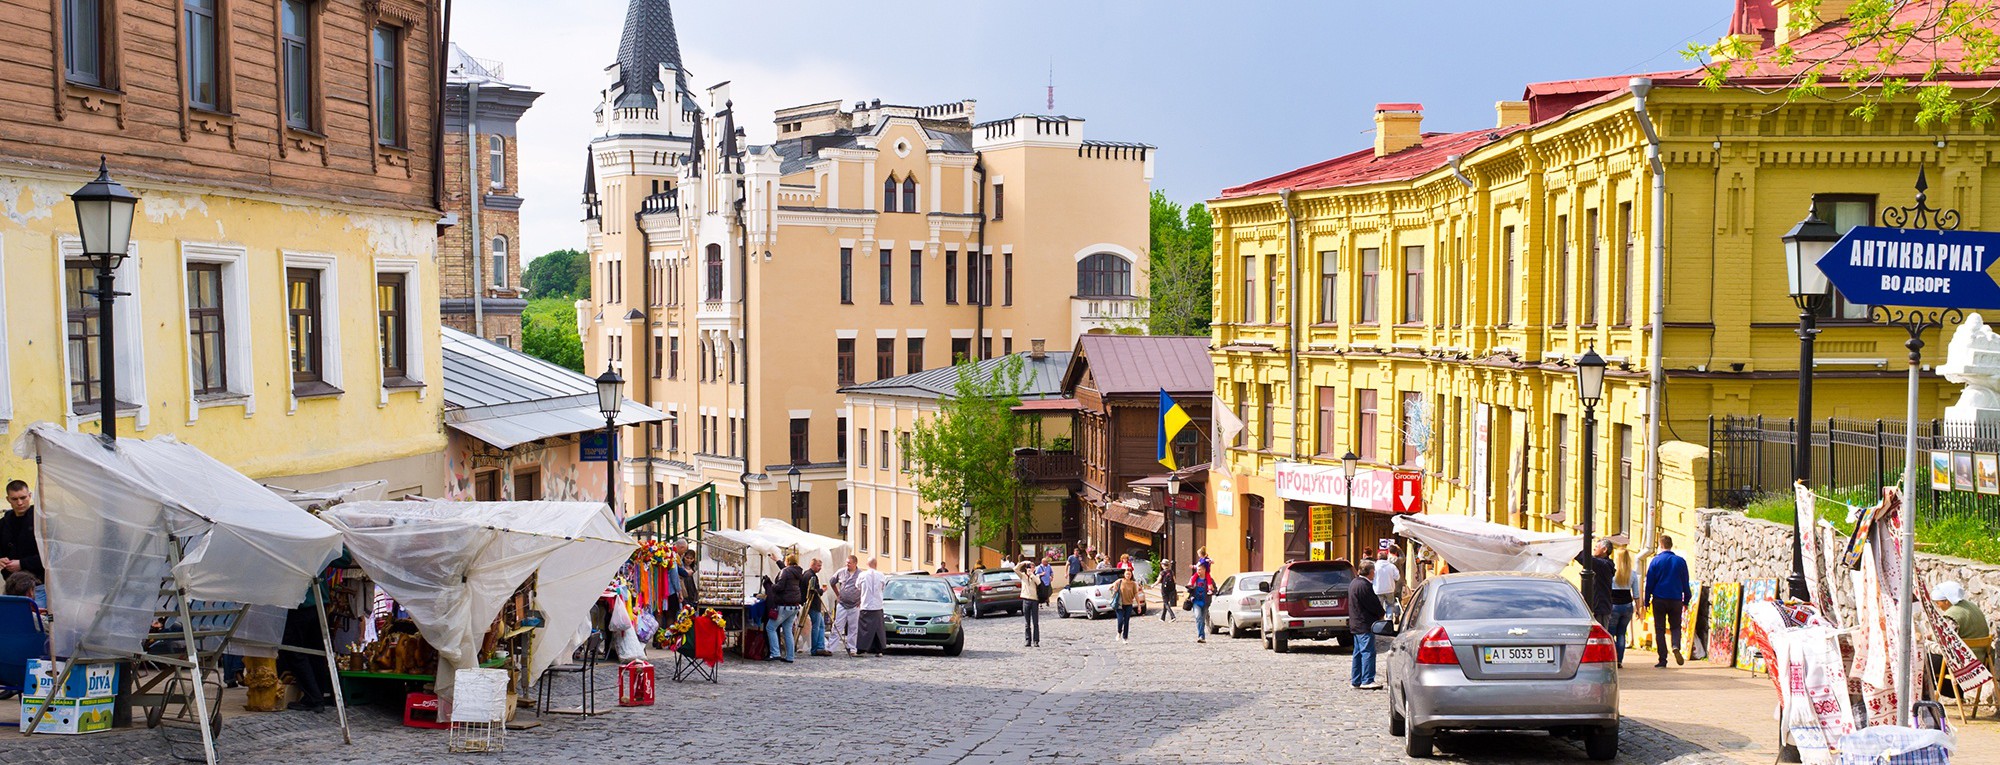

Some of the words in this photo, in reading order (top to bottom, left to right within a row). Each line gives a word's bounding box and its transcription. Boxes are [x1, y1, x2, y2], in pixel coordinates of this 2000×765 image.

[1850, 239, 1985, 272] АНТИКВАРИАТ
[1881, 275, 1900, 291] ВО
[1903, 276, 1951, 294] ДВОРЕ
[1394, 472, 1421, 481] Grocery
[1278, 471, 1369, 498] ПРОДУКТОРИЯ
[1372, 480, 1393, 501] 24
[1492, 649, 1505, 659] AI
[1509, 648, 1533, 659] 5033
[1537, 648, 1550, 659] BI
[40, 677, 54, 686] DIV
[88, 676, 110, 691] DIVA
